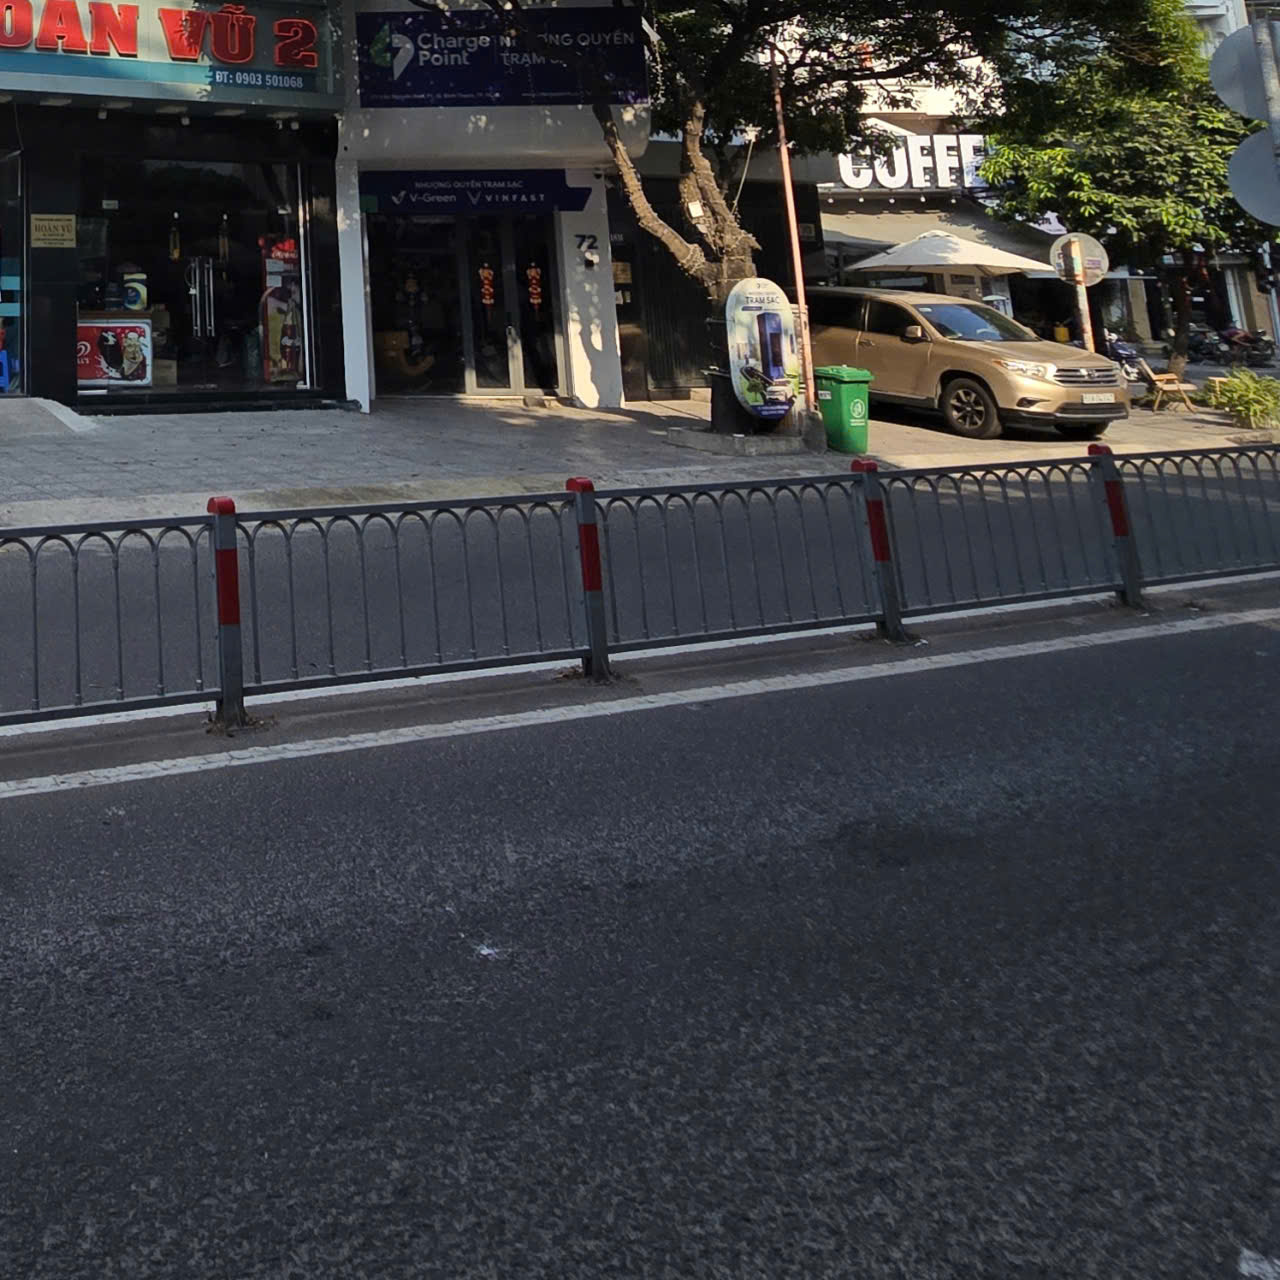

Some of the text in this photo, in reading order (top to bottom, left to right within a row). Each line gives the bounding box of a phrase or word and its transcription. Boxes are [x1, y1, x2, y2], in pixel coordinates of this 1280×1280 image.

[158, 3, 256, 65] VŨ
[273, 19, 319, 68] 2
[417, 32, 491, 52] Charge
[500, 33, 573, 47] NNG
[419, 50, 470, 66] Point
[236, 71, 263, 86] 0903
[265, 73, 304, 89] 501068
[409, 193, 545, 204] V-Green VINFAST
[574, 234, 599, 250] 72
